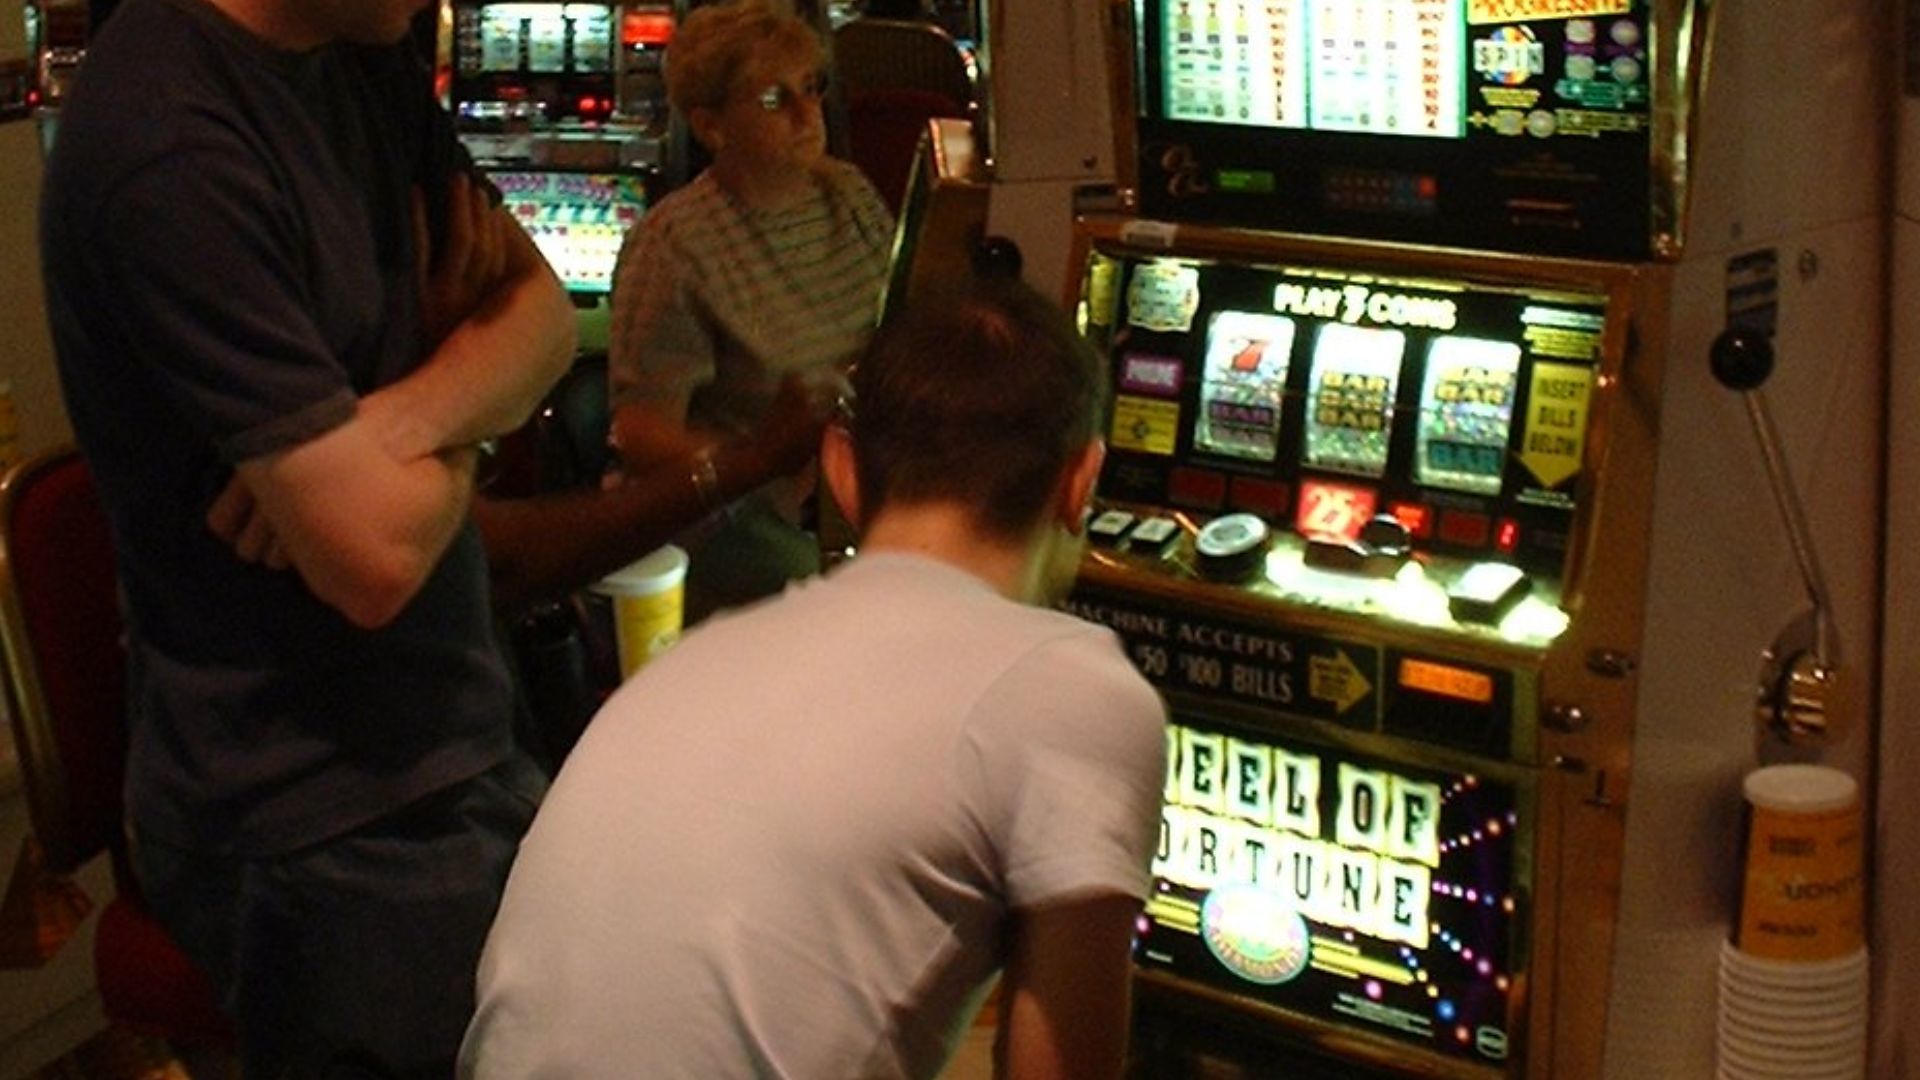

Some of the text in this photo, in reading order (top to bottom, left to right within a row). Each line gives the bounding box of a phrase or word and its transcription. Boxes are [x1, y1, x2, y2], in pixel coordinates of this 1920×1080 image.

[1479, 45, 1543, 68] SPIN
[1273, 283, 1343, 318] PLAY
[1368, 293, 1457, 330] COINS
[1536, 378, 1586, 399] INSERT
[1538, 405, 1577, 428] BILLS
[1528, 432, 1578, 458] BELOW
[1177, 623, 1294, 663] ACCEPTS
[1231, 662, 1294, 703] BILLS
[1353, 781, 1429, 845] OF
[1158, 817, 1413, 927] ORTUNE
